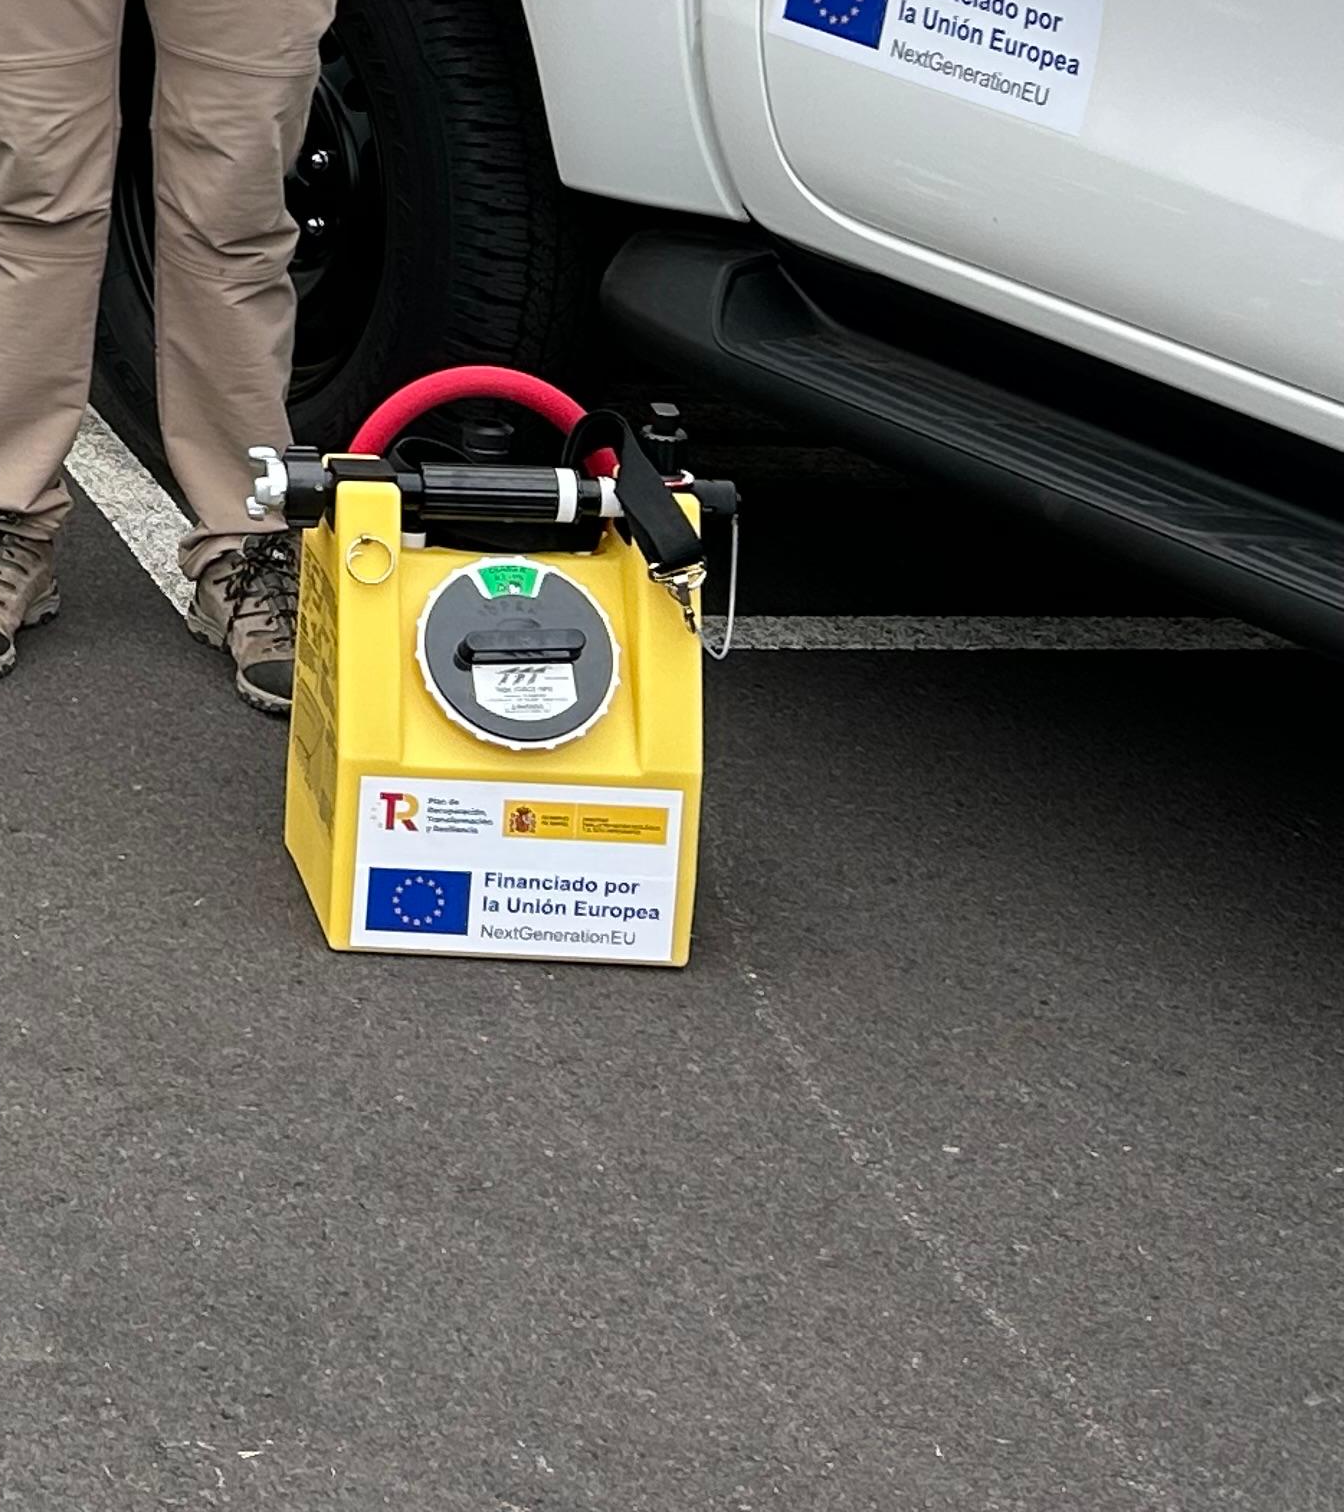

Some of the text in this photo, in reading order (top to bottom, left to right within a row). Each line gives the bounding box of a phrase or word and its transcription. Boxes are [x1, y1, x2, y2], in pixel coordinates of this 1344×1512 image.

[1024, 8, 1063, 33] por
[899, 0, 1080, 75] la Unión Europea
[891, 40, 1049, 106] NextGenerationEU
[485, 872, 639, 898] Financiado por
[483, 895, 660, 921] la Unión Europea
[481, 925, 636, 945] NextGenerationEU
